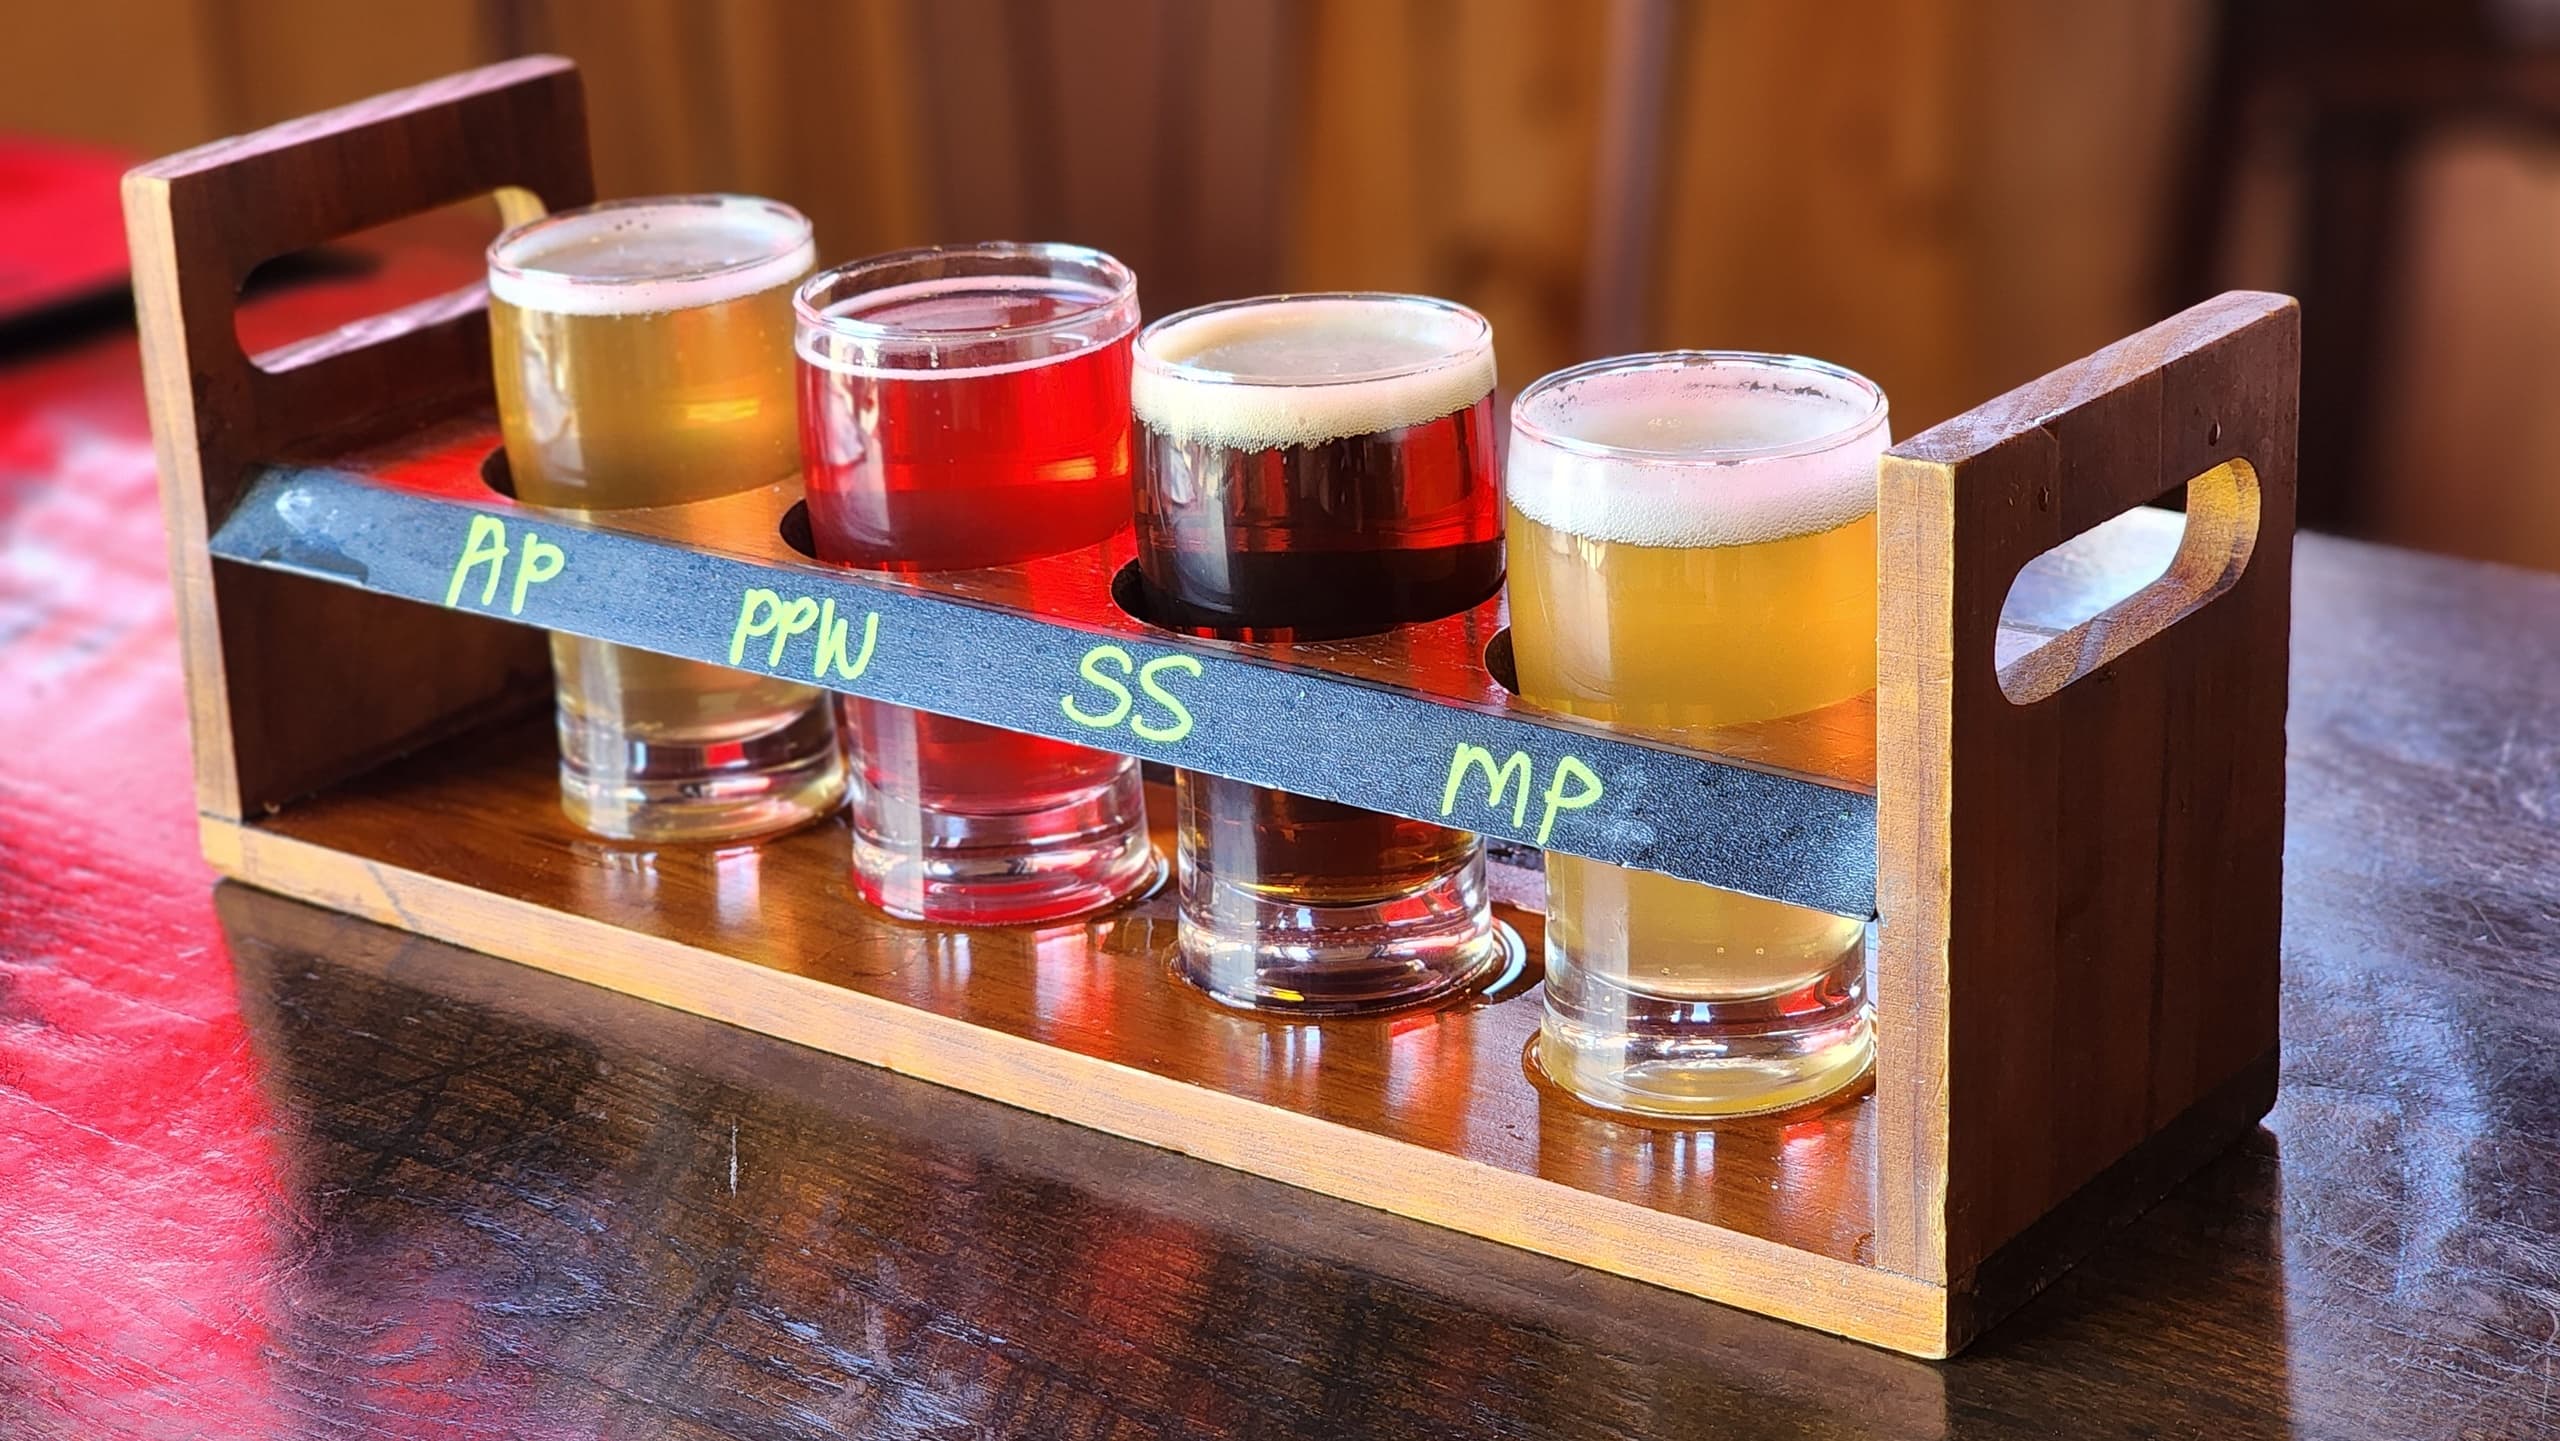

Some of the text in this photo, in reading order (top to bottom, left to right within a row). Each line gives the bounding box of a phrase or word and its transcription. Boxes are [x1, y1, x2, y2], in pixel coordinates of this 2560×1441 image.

[446, 514, 566, 615] AP
[729, 588, 880, 680] PPW
[1061, 645, 1203, 742] SS
[1441, 742, 1604, 845] MP
